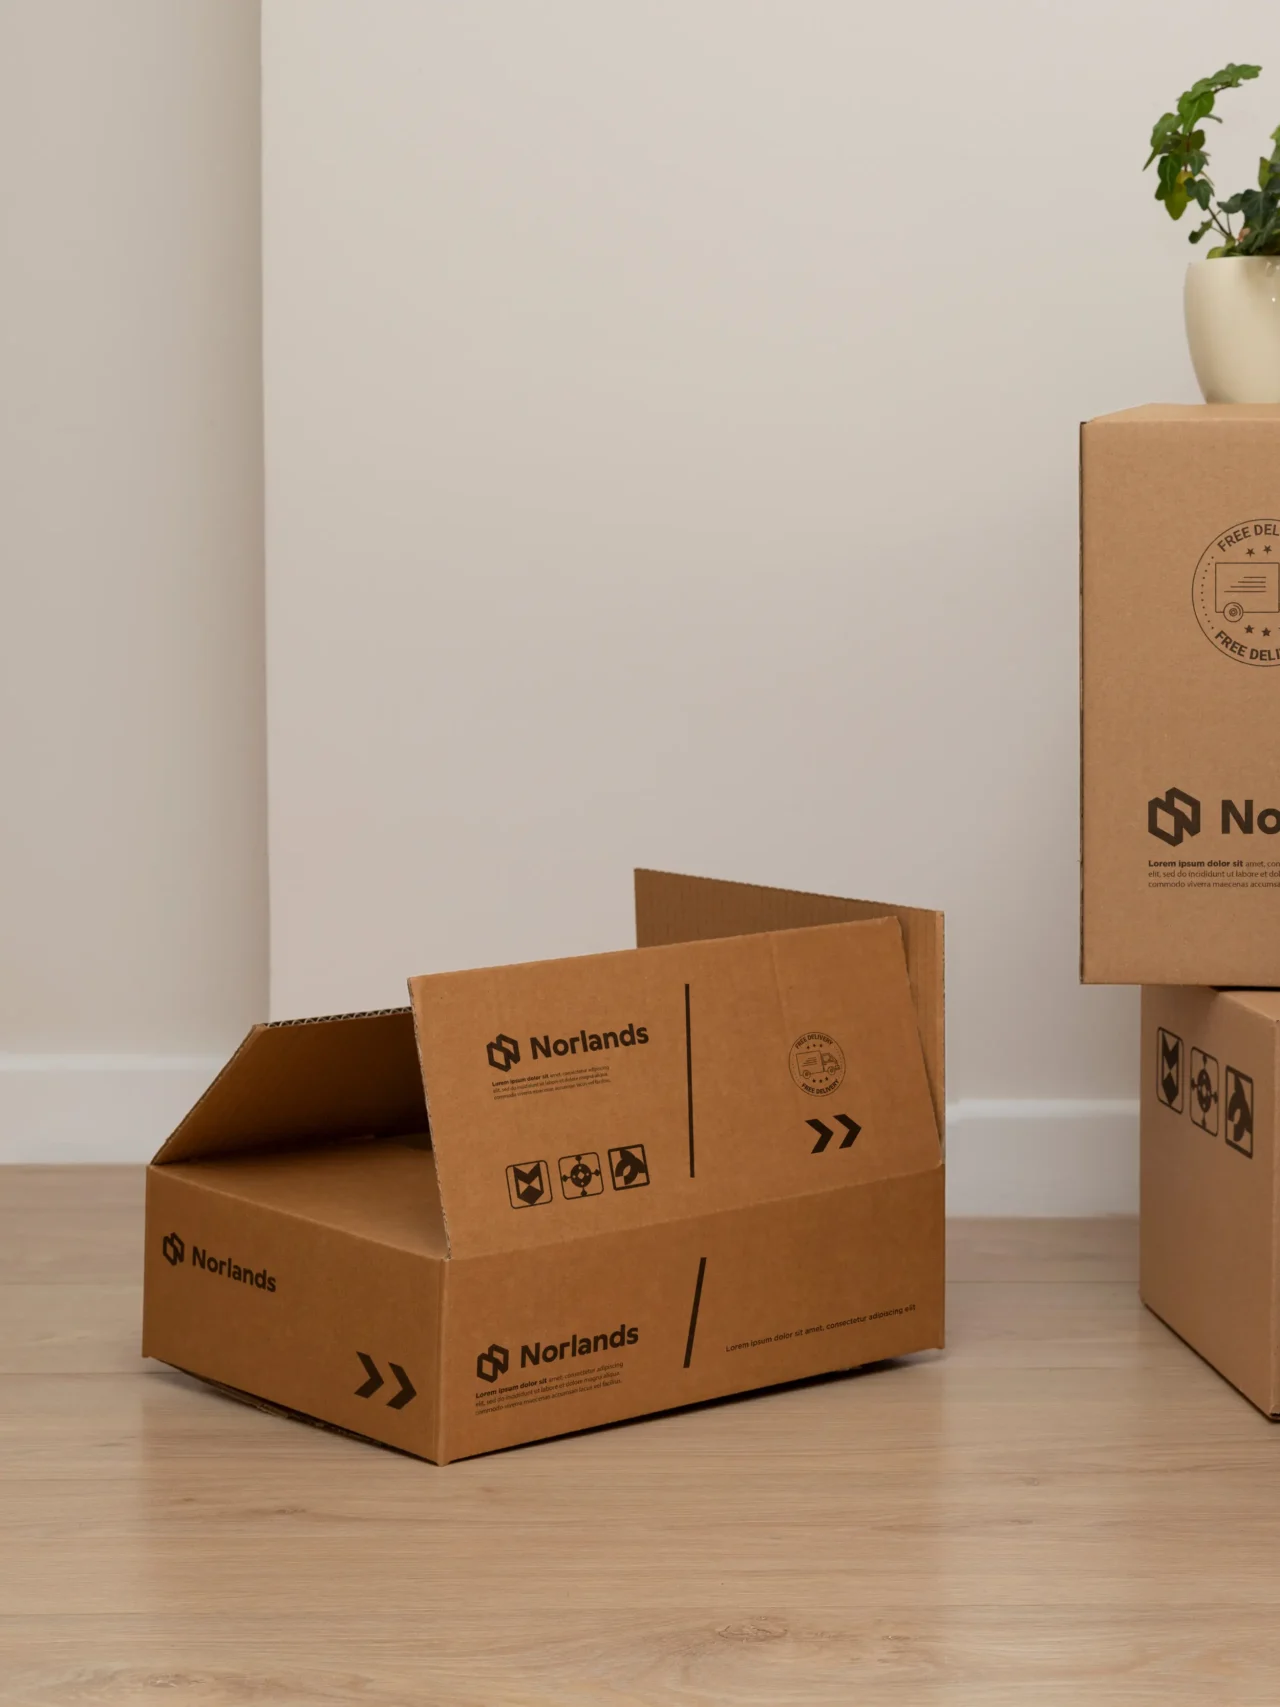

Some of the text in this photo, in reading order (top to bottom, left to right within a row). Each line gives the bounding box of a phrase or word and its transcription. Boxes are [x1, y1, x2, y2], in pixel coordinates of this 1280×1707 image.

[1217, 526, 1251, 552] FREE
[1215, 630, 1248, 657] FREE
[1179, 860, 1205, 868] ipsum
[530, 1023, 649, 1060] Norlands
[192, 1246, 276, 1293] Norlands
[521, 1324, 639, 1368] Norlands
[726, 1342, 749, 1352] Lorem
[751, 1337, 773, 1347] ipsum
[774, 1332, 793, 1342] dolor
[794, 1329, 803, 1337] sit
[805, 1325, 825, 1335] amet,
[826, 1316, 867, 1330] consectetur
[869, 1308, 903, 1321] adipiscing
[476, 1390, 497, 1398] Lorem
[498, 1385, 519, 1394] ipsum
[520, 1380, 537, 1388] dolor
